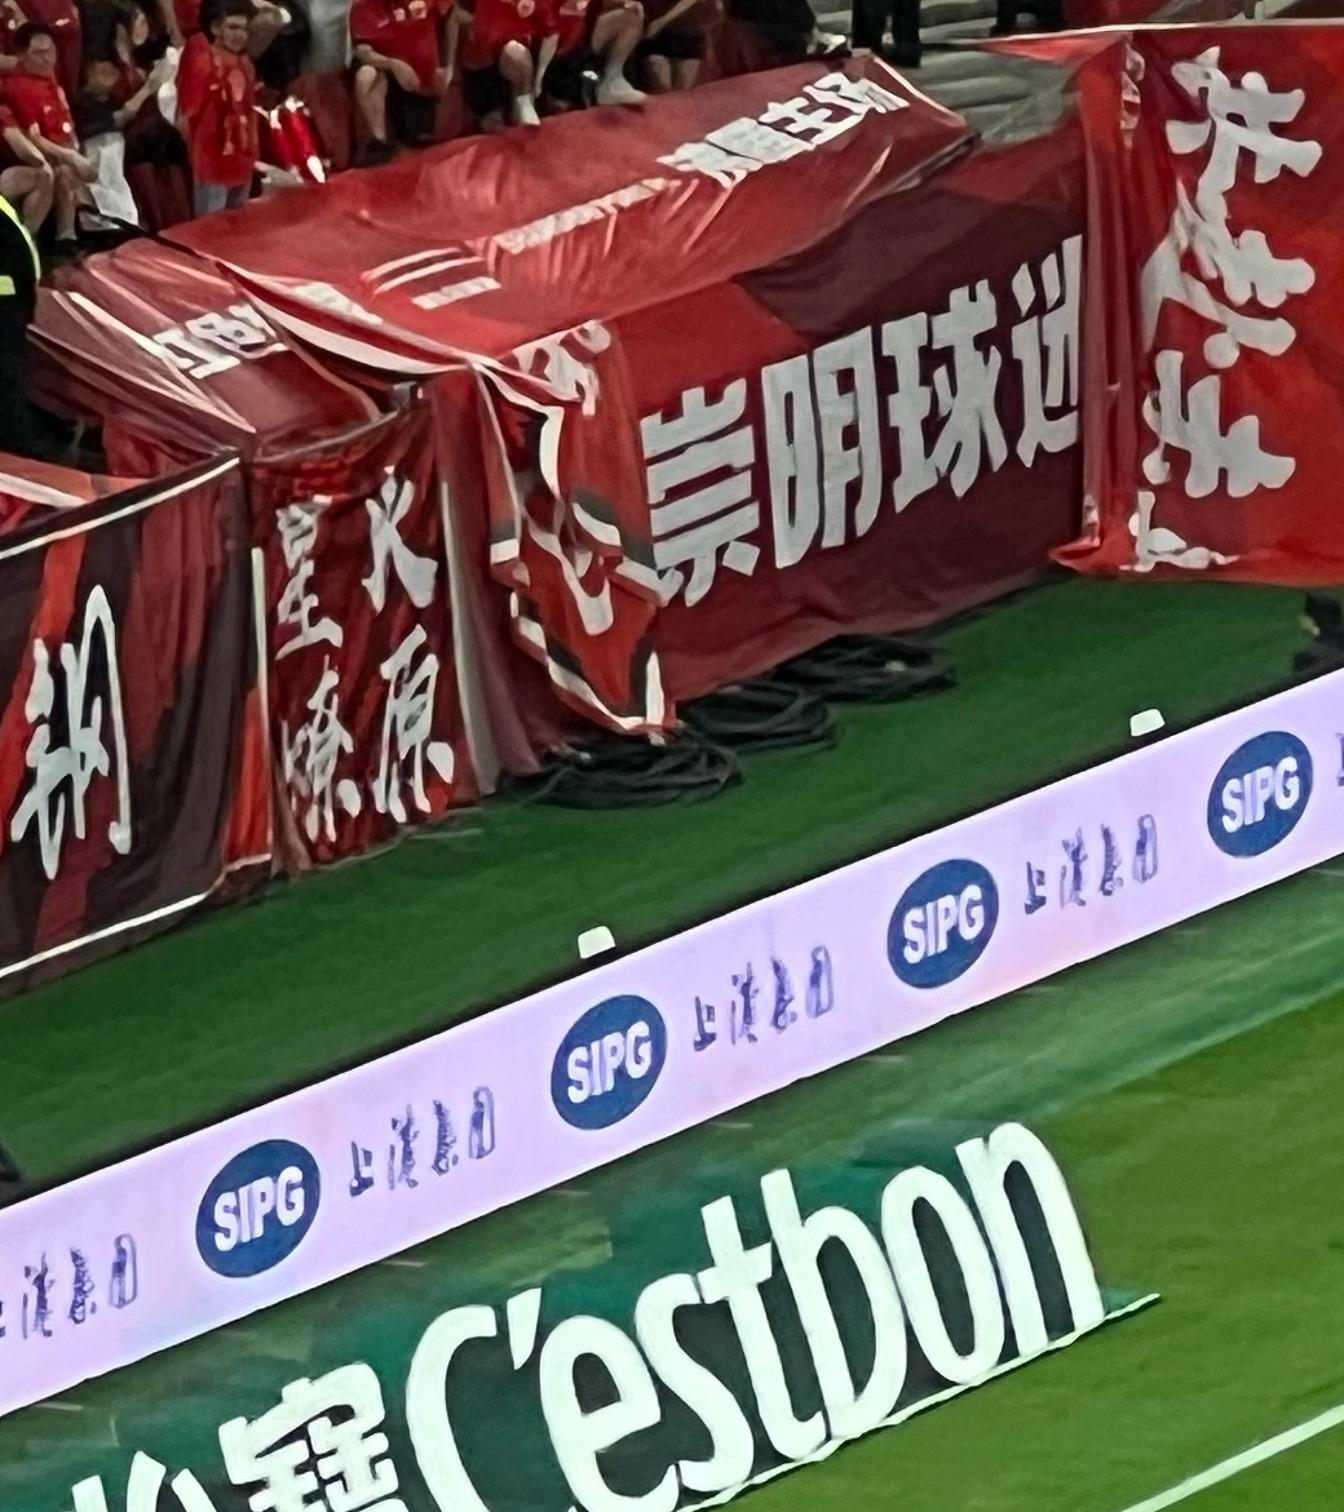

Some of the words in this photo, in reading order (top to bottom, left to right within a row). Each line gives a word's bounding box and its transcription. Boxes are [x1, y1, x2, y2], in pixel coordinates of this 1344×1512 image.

[1221, 755, 1298, 834] SIPG
[902, 884, 985, 964] SIPG
[566, 1021, 652, 1104] SIPG
[212, 1166, 304, 1253] SIPG
[0, 1234, 137, 1340] 港集团
